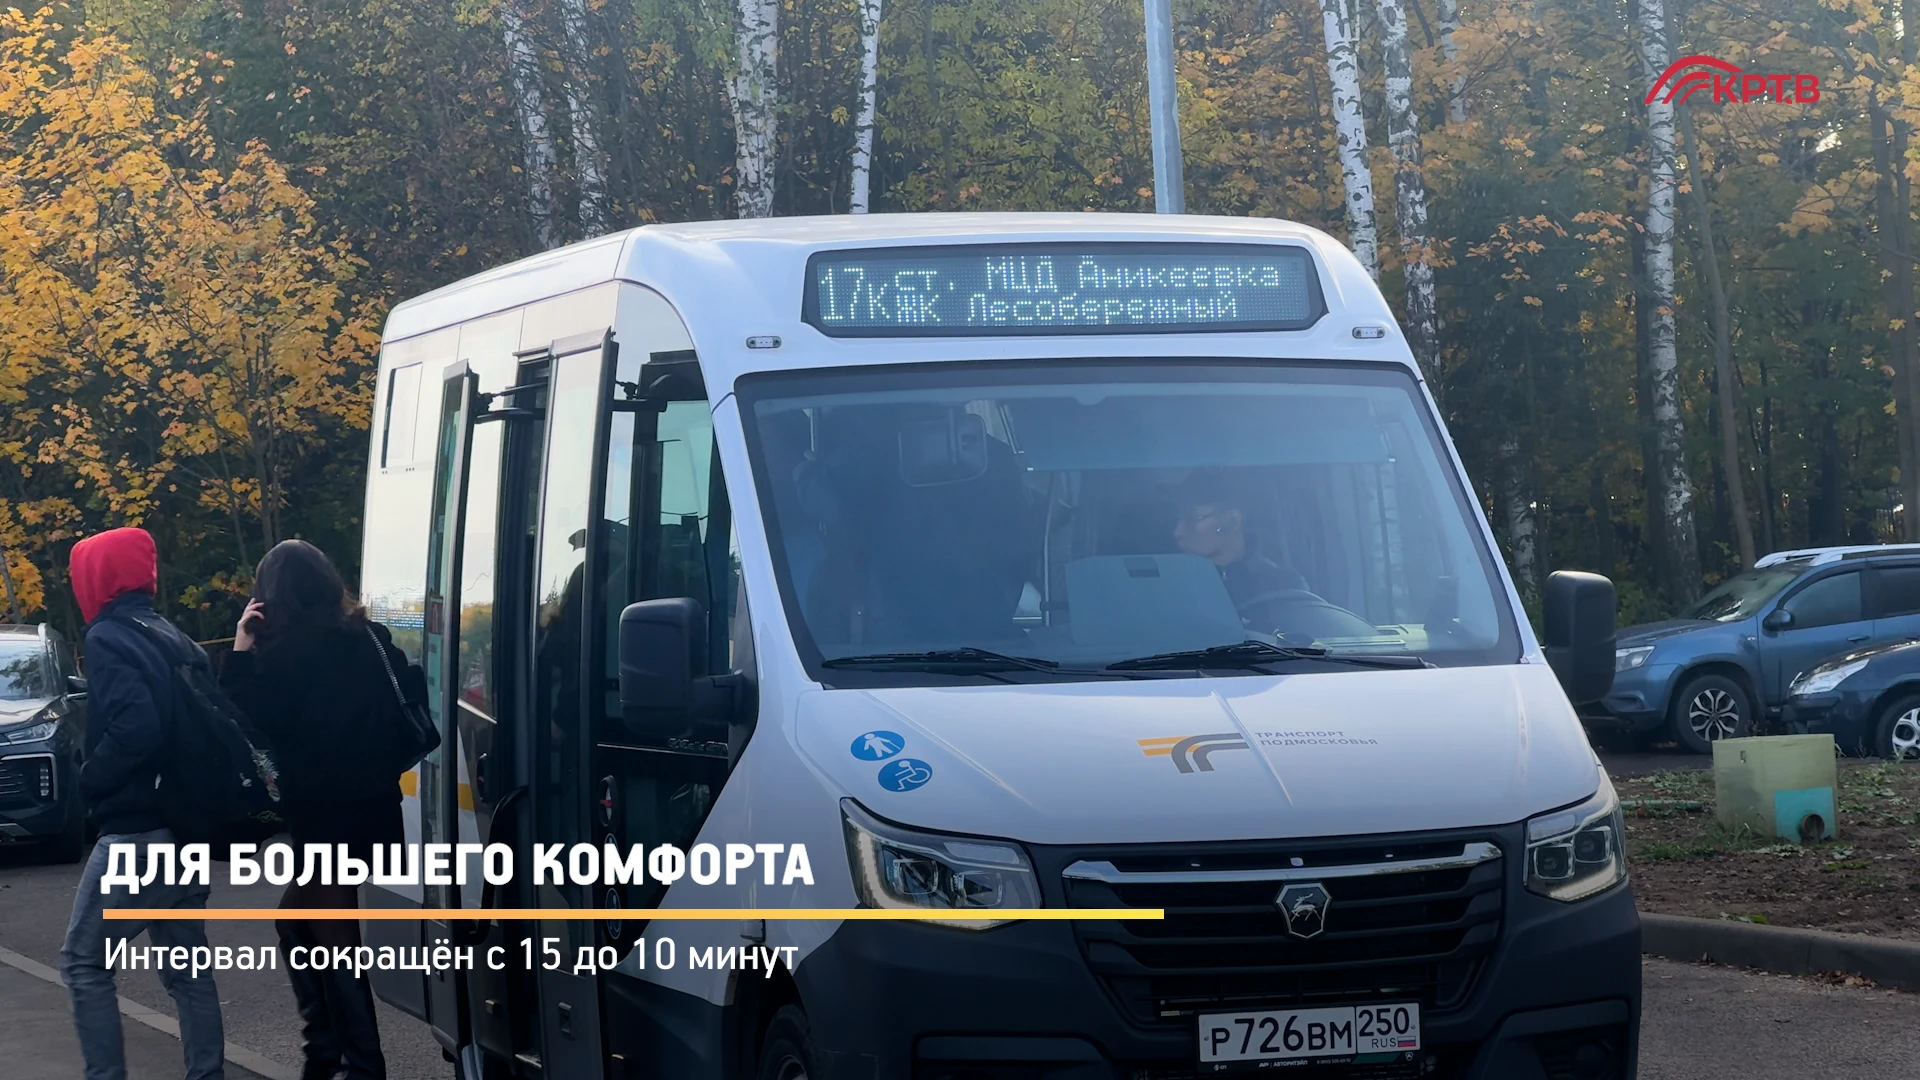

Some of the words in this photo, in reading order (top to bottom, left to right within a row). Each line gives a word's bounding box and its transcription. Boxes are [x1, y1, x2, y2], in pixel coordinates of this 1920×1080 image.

[986, 260, 1058, 292] МЦД
[1078, 260, 1279, 288] Аникеевка
[896, 294, 941, 323] ЖК
[967, 290, 1237, 324] Лесобережный
[1260, 738, 1379, 746] ПОДМОСКОВЬЯ
[1358, 1007, 1410, 1037] 250
[1371, 1037, 1397, 1048] RUS
